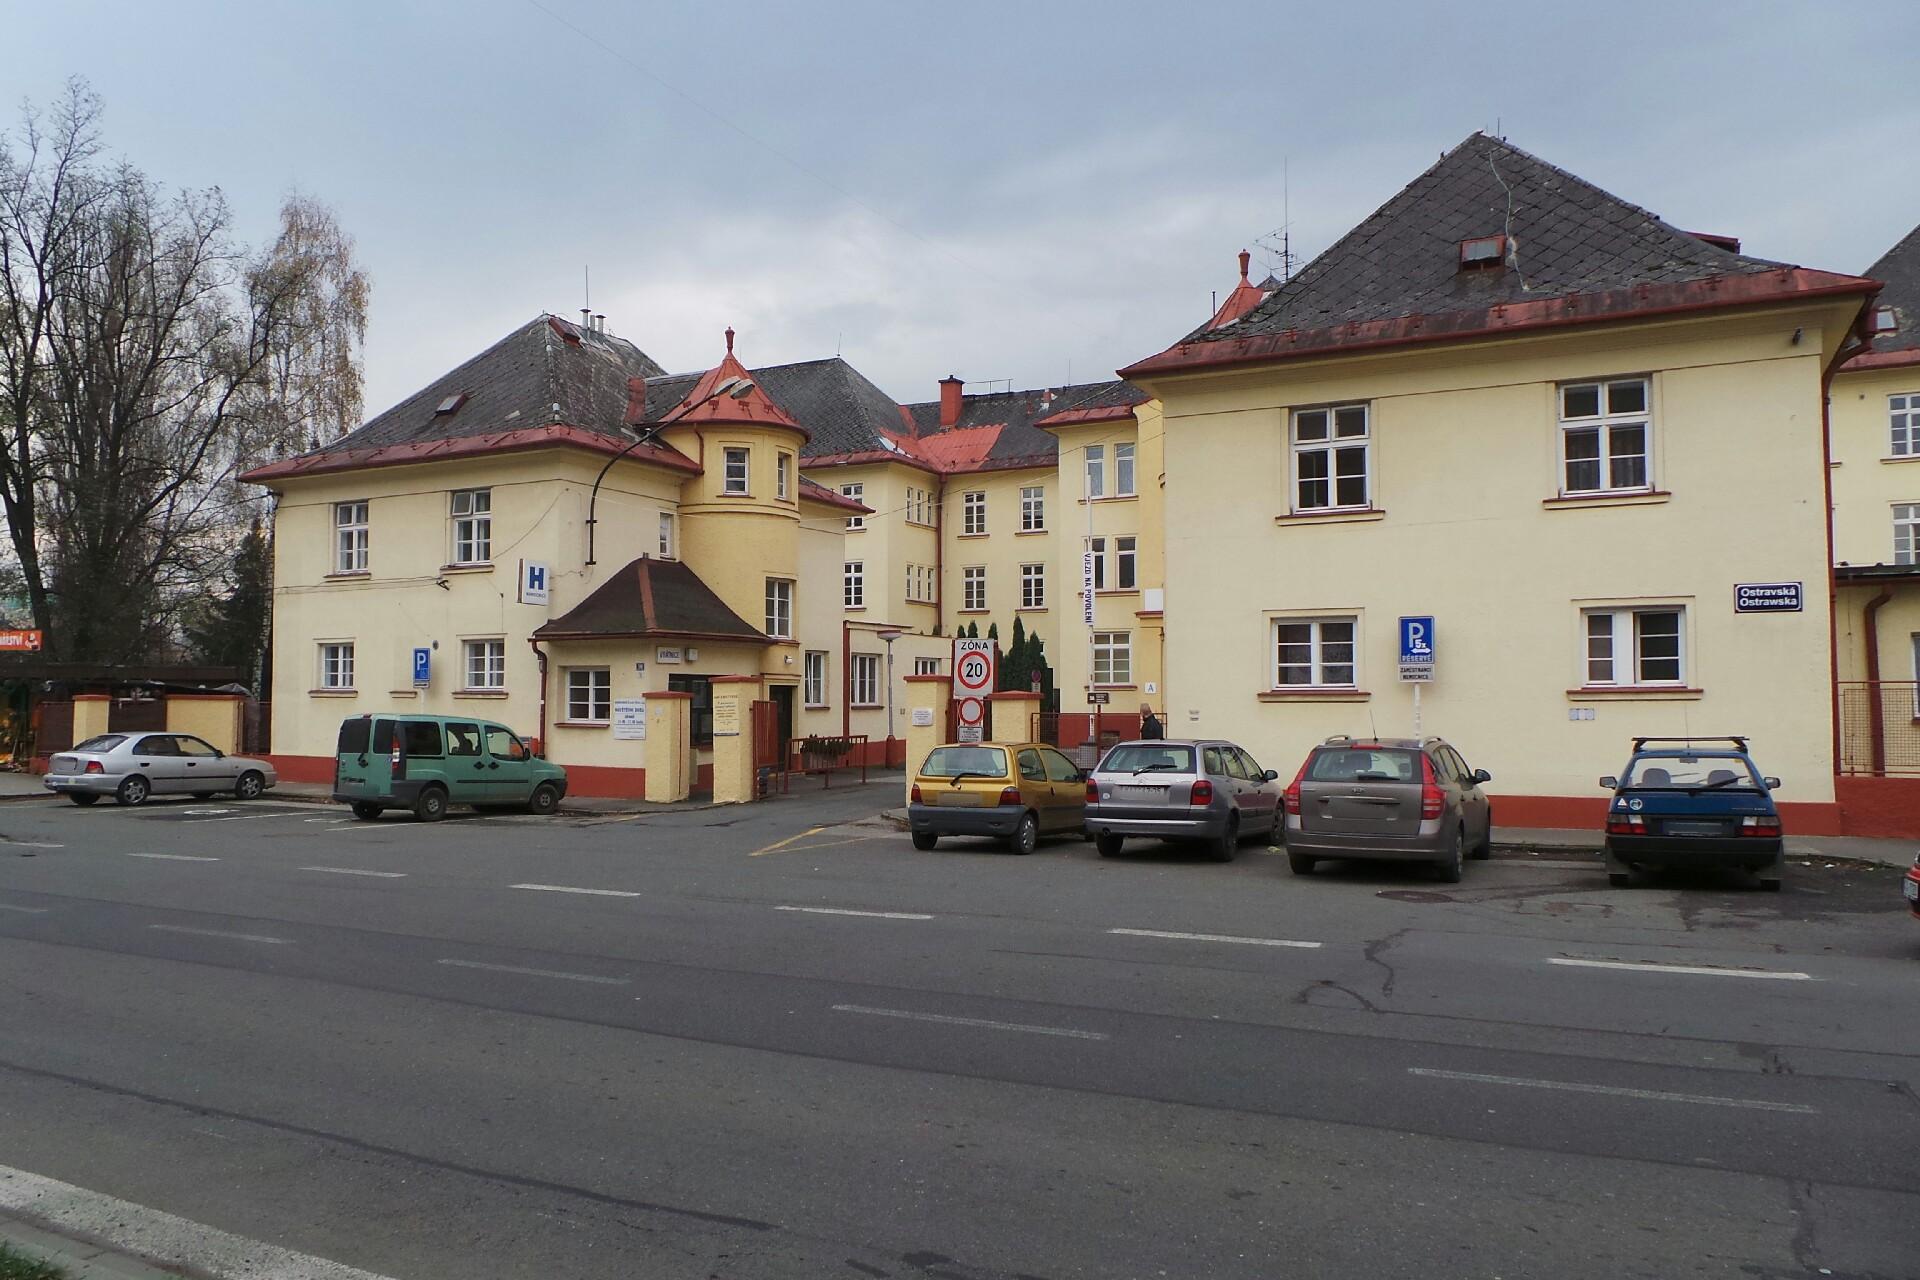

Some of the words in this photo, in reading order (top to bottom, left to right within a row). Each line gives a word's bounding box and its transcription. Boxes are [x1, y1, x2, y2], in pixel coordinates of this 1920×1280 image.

[1084, 553, 1092, 575] VJEZD
[529, 566, 544, 590] H
[1084, 577, 1092, 587] NA
[1741, 587, 1796, 597] Ostravská
[1740, 597, 1798, 606] Ostrawska
[1409, 622, 1424, 648] P
[961, 640, 988, 650] ZÓNA
[1415, 639, 1426, 648] 5x
[417, 652, 426, 671] P
[965, 662, 983, 678] 20
[1147, 683, 1155, 693] A
